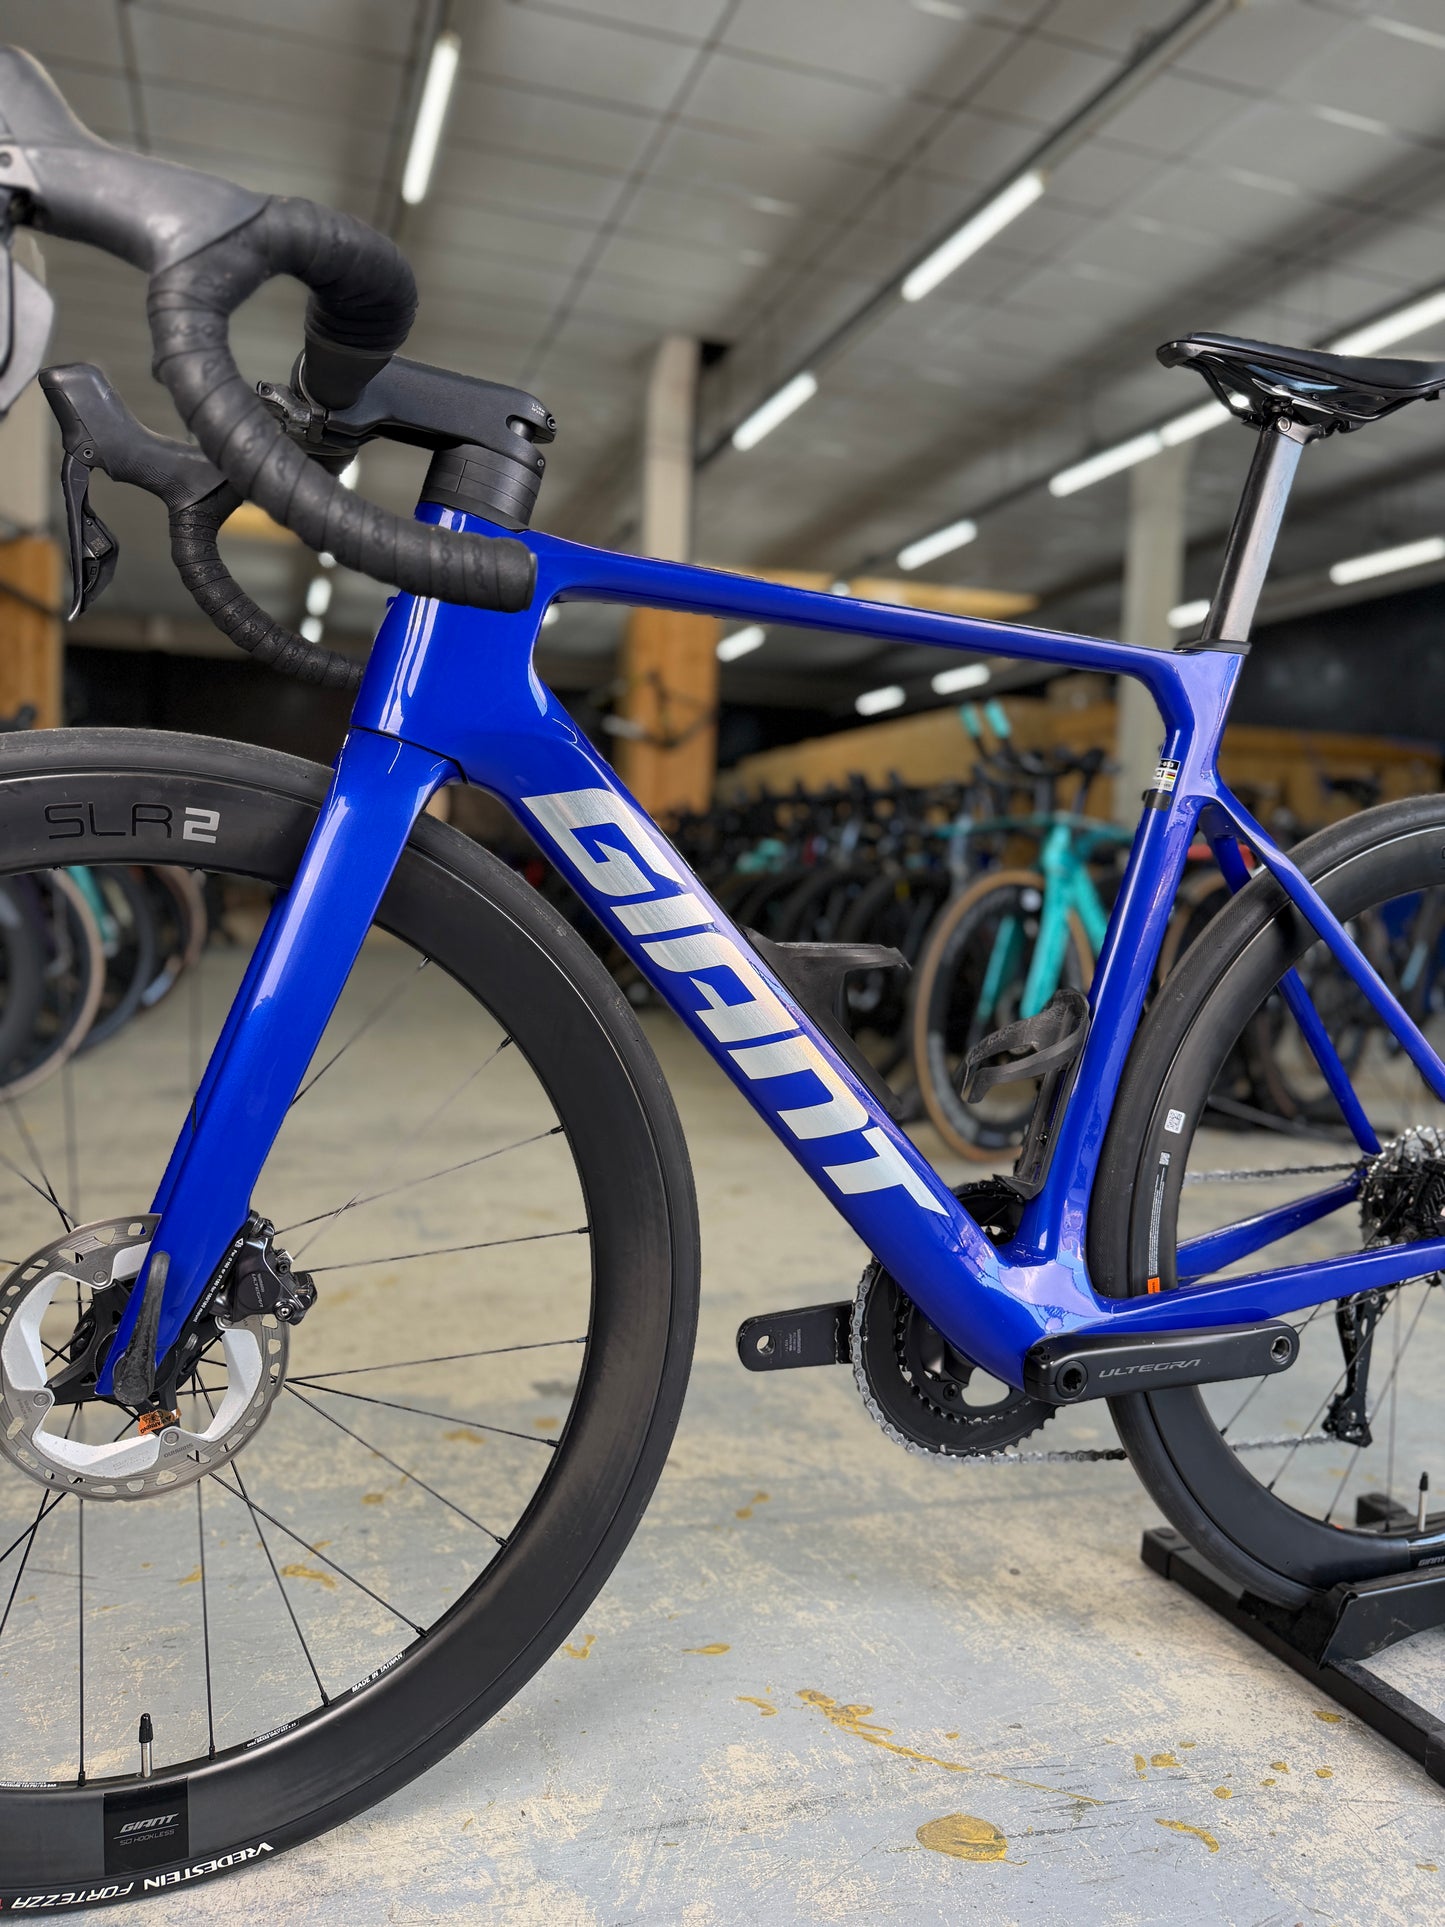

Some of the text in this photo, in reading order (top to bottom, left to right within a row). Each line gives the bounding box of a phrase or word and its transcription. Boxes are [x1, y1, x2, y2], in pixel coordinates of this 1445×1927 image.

[44, 801, 221, 844] SLR 2
[520, 787, 950, 1218] GIANT
[252, 1273, 264, 1308] ULTEGRA
[1098, 1358, 1201, 1379] ULTEGRA
[351, 1652, 403, 1692] MADE IN TAIWAN
[120, 1813, 179, 1833] GIANT
[134, 1829, 175, 1843] HOOKLESS
[11, 1841, 274, 1909] VREDESTEIN FORTEZZA
